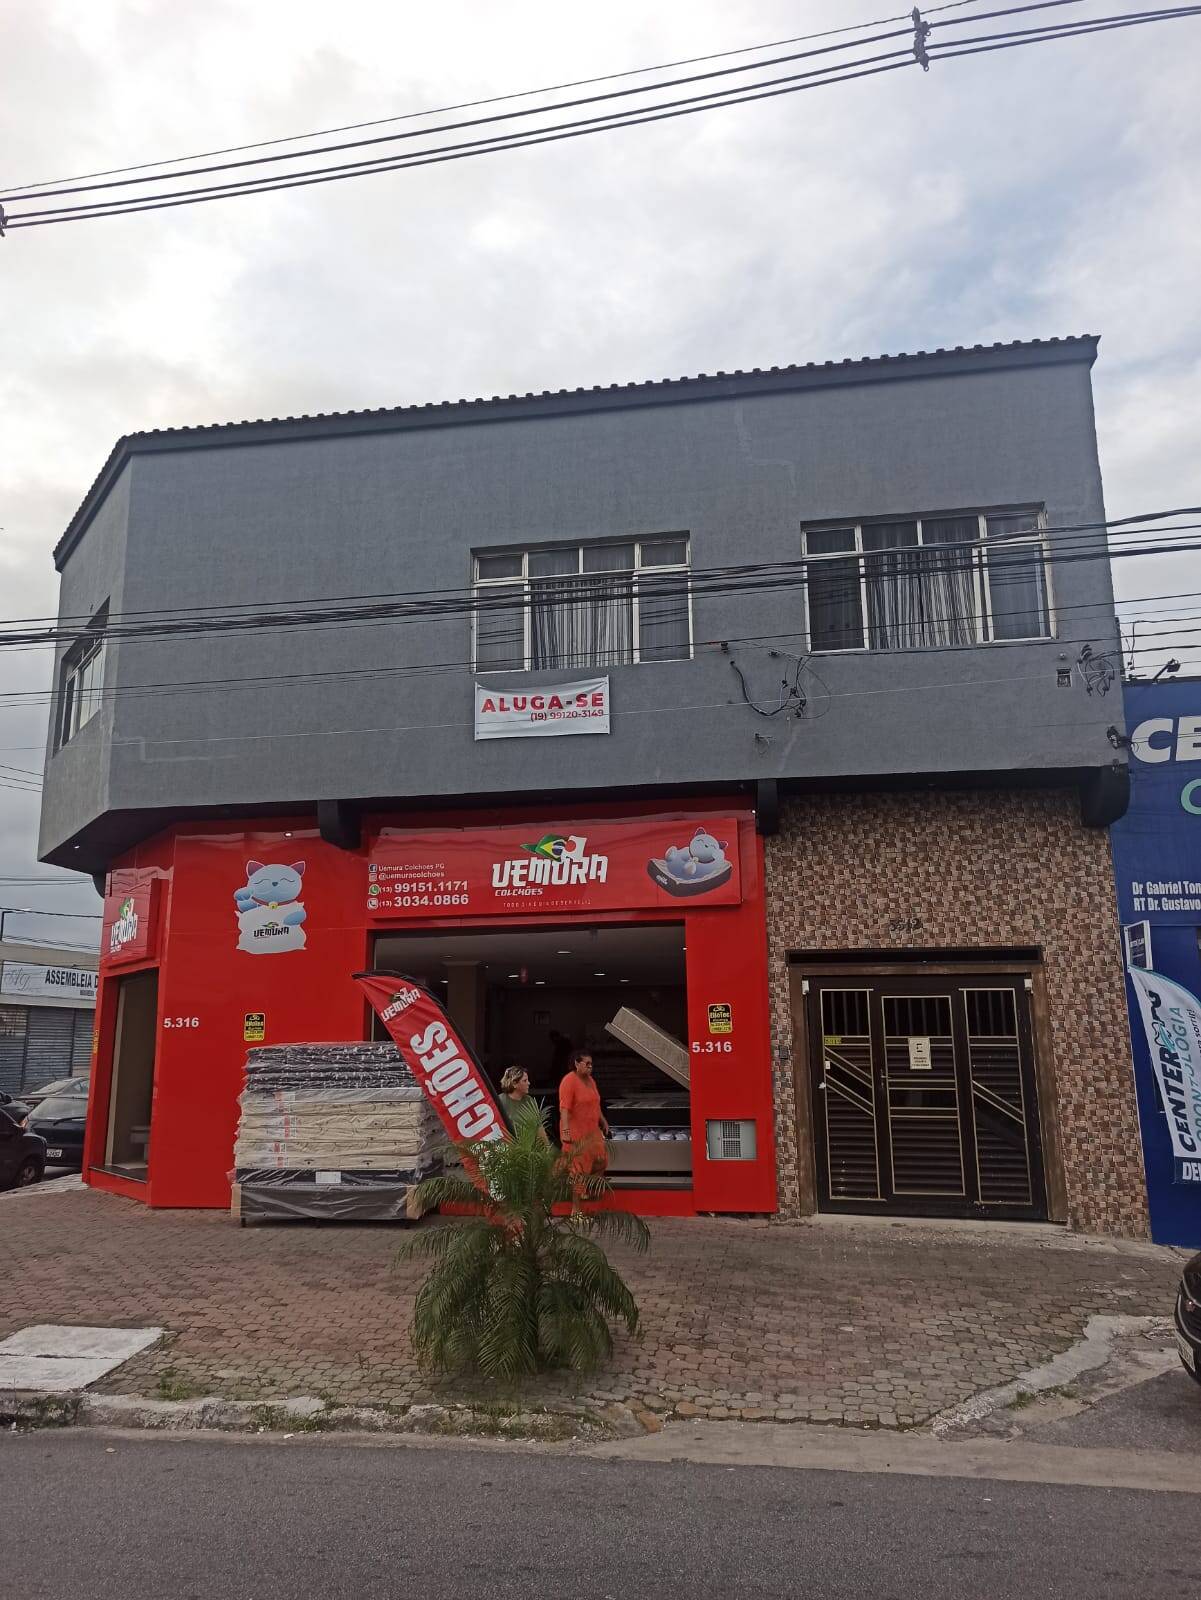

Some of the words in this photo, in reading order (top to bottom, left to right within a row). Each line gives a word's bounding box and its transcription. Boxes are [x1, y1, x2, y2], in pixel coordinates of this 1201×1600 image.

[481, 692, 604, 713] ALUGA-SE
[530, 711, 547, 722] (19)
[550, 709, 604, 719] 99120-3149
[492, 853, 609, 888] UEMURA
[394, 880, 468, 893] 99151.1171
[494, 886, 544, 897] COLCHÕES
[1132, 881, 1144, 895] Dr
[1146, 880, 1183, 895] Gabriel
[394, 894, 469, 907] 3034.0866
[1133, 897, 1146, 911] RT
[1147, 897, 1161, 911] Dr.
[1161, 896, 1201, 911] Gustavo
[253, 926, 290, 938] UEMURA
[45, 969, 92, 988] ASSEMBLEIA
[163, 1017, 200, 1028] 5.316
[692, 1041, 732, 1053] 5.316
[1158, 1047, 1197, 1153] CENTER
